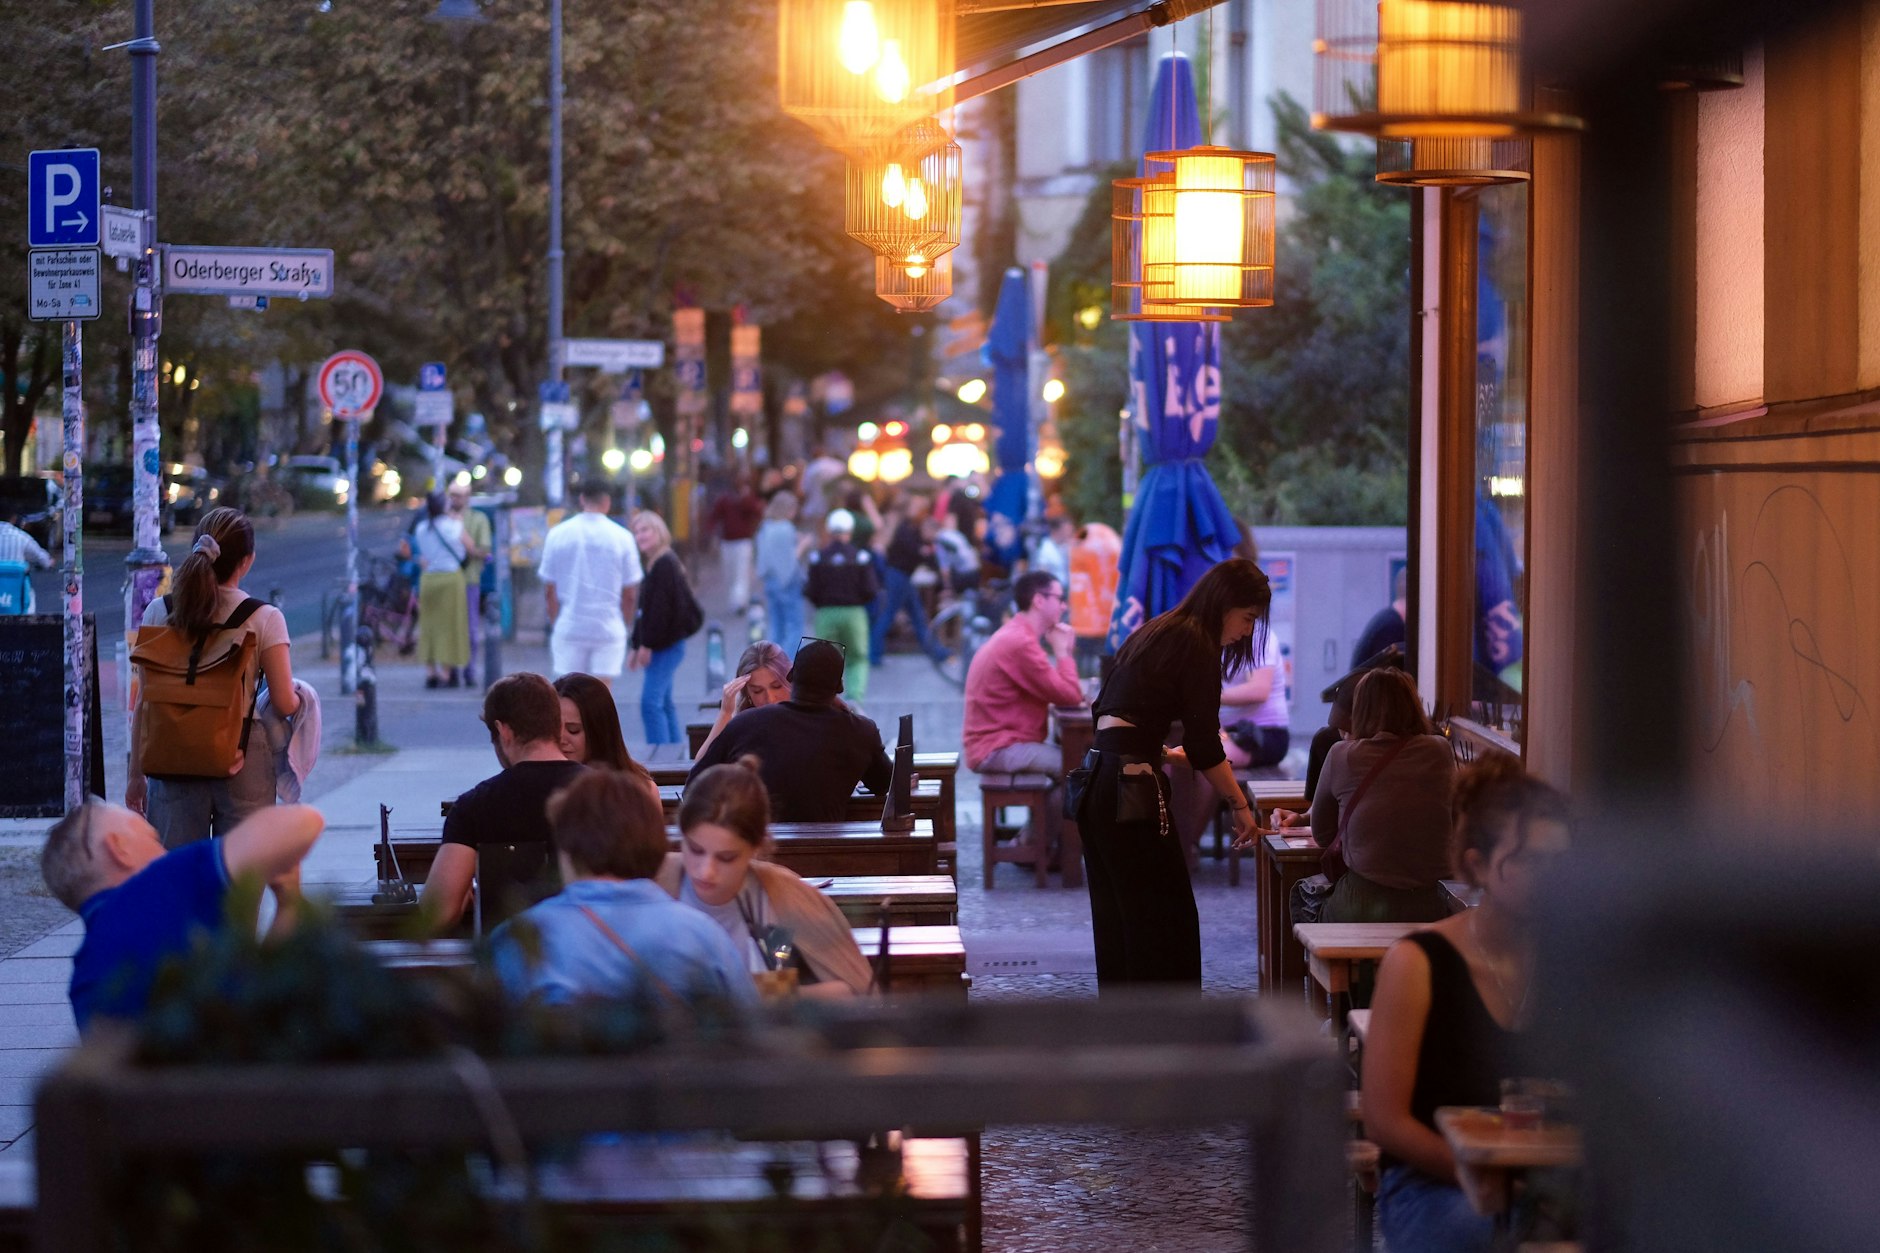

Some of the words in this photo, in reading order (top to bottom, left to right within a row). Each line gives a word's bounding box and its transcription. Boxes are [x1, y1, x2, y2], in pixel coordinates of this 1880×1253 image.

[46, 163, 81, 233] P
[36, 256, 45, 265] mit
[47, 255, 77, 264] Parkschein
[79, 254, 92, 264] oder
[33, 267, 95, 278] Bewohnerparkausweis
[174, 258, 265, 285] Oderberger
[48, 279, 56, 289] für
[58, 279, 72, 289] Zone
[334, 369, 369, 400] 50
